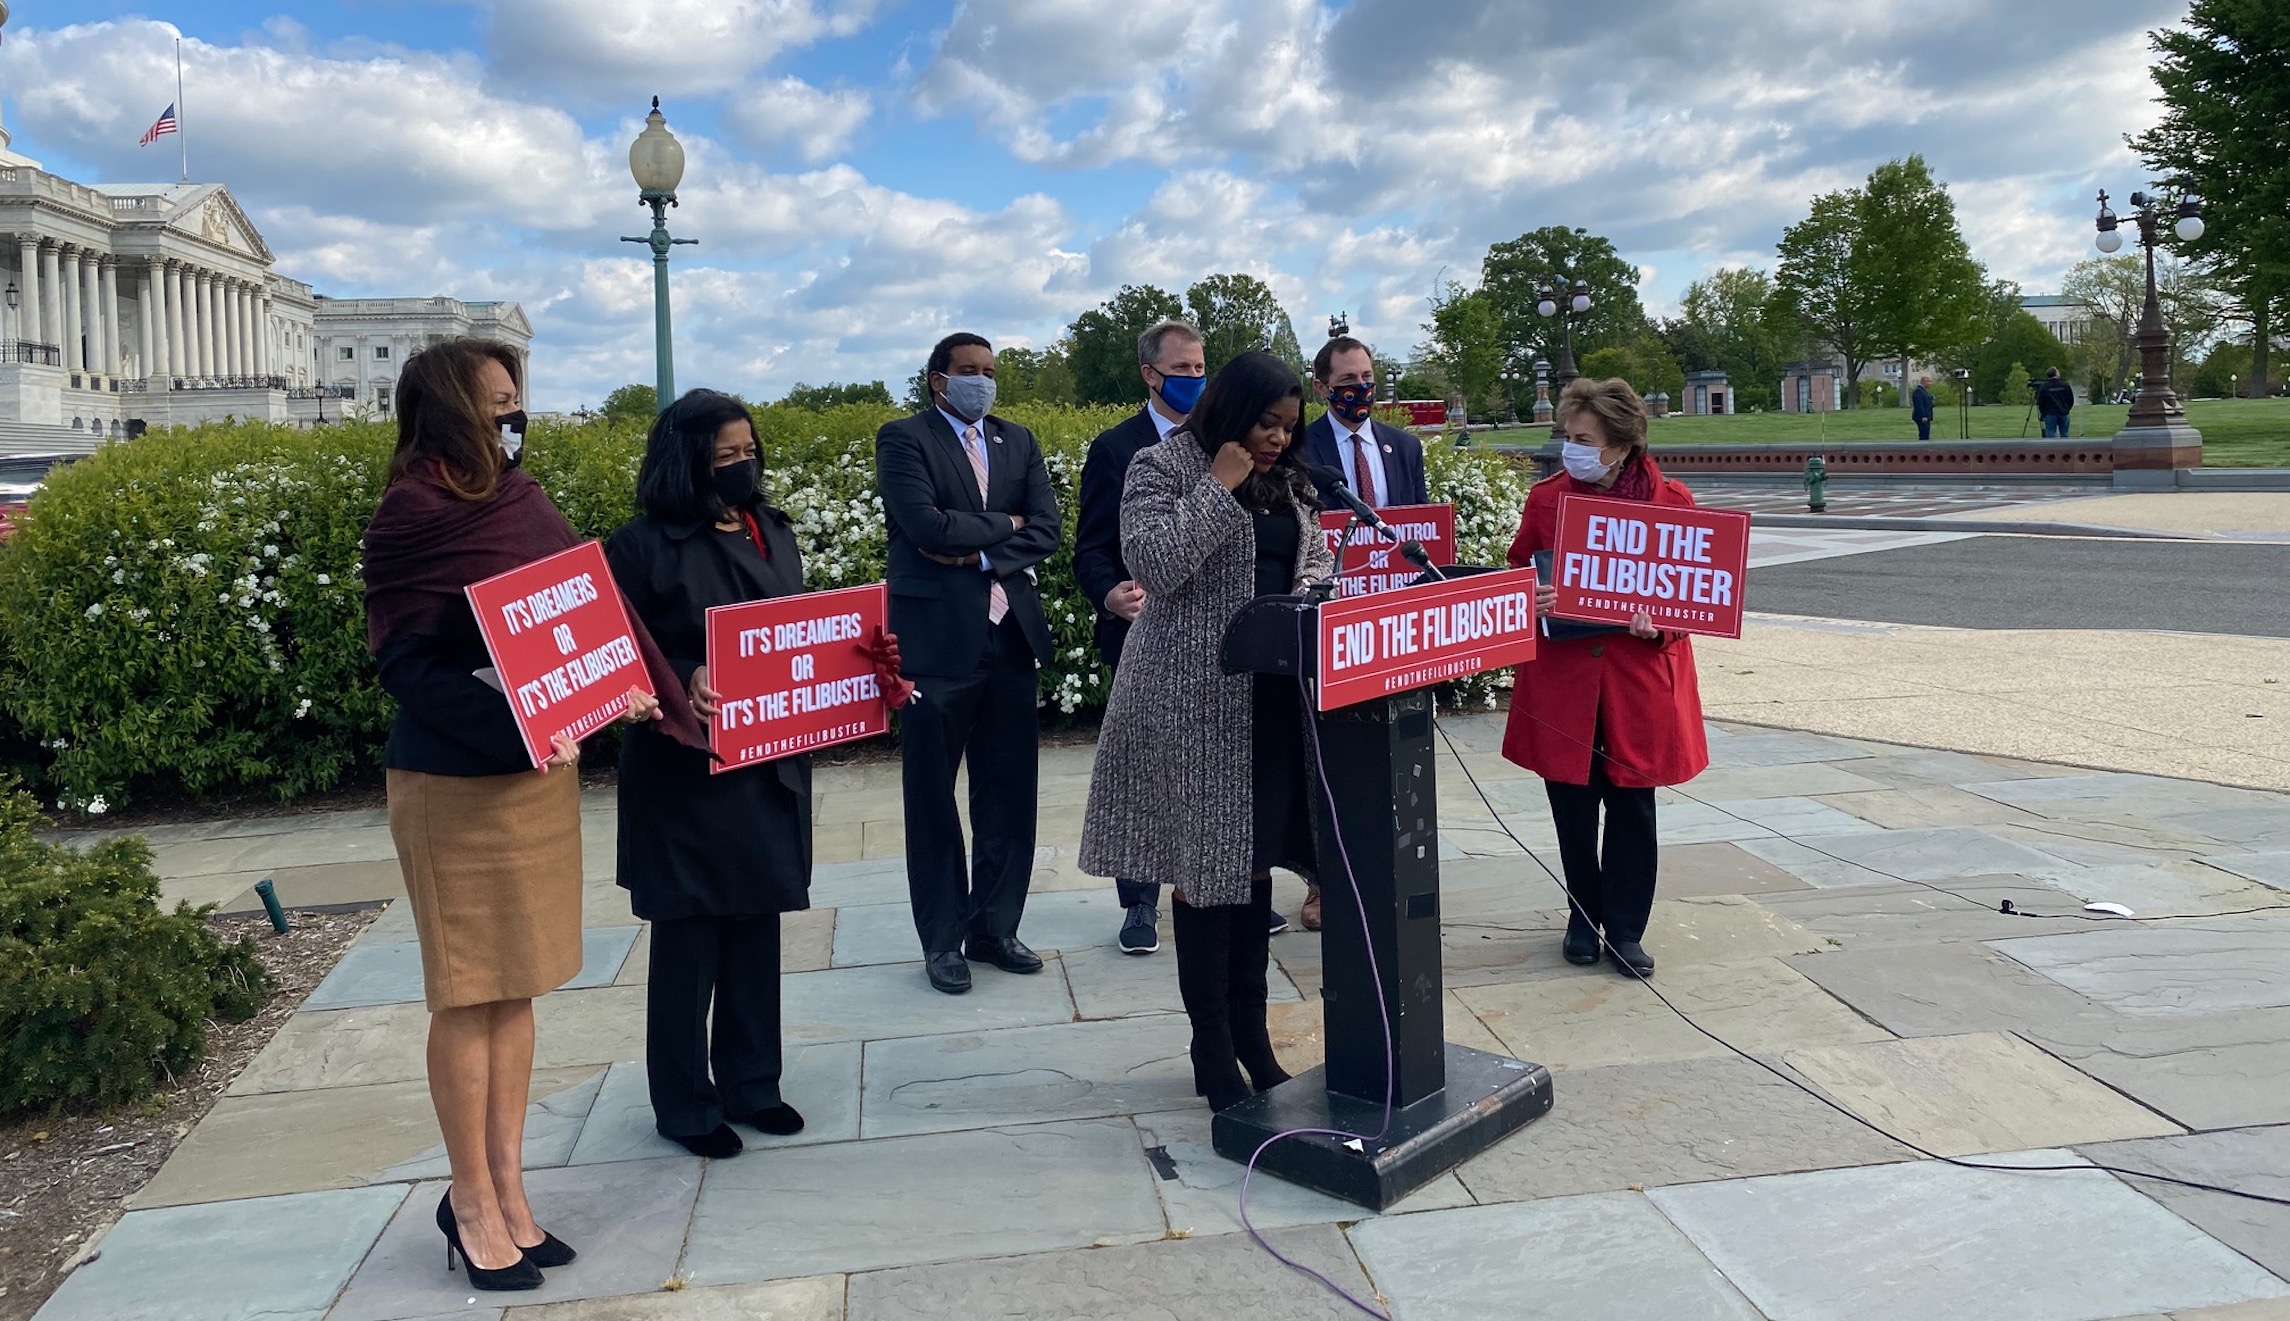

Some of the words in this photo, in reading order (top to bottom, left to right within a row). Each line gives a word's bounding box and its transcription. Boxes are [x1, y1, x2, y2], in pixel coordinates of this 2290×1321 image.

[1322, 528, 1342, 548] T'S
[1587, 515, 1648, 556] END
[1655, 522, 1715, 564] THE
[1369, 550, 1389, 570] OR
[1563, 552, 1733, 607] FILIBUSTER
[501, 599, 533, 636] IT'S
[526, 572, 598, 625] DREAMERS
[1340, 575, 1368, 597] THE
[1370, 572, 1425, 594] FILIBU
[1579, 596, 1715, 622] #ENDTHEFILIBUSTER
[552, 622, 578, 656] OR
[739, 626, 771, 658] IT'S
[774, 612, 862, 652] DREAMERS
[1332, 620, 1375, 671] END
[1379, 611, 1419, 660] THE
[1423, 591, 1528, 651] FILIBUSTER
[517, 679, 548, 719] IT'S
[540, 666, 574, 704] THE
[565, 635, 638, 692] FILIBUSTER
[791, 653, 814, 682] OR
[1384, 656, 1482, 691] #ENDTHEFILIBUSTER
[550, 691, 630, 742] NDTHEFILIBUST
[721, 698, 754, 731] IT'S
[756, 690, 790, 723] THE
[792, 673, 881, 715] FILIBUSTER
[739, 721, 867, 761] #ENDTHEFILIBUSTER
